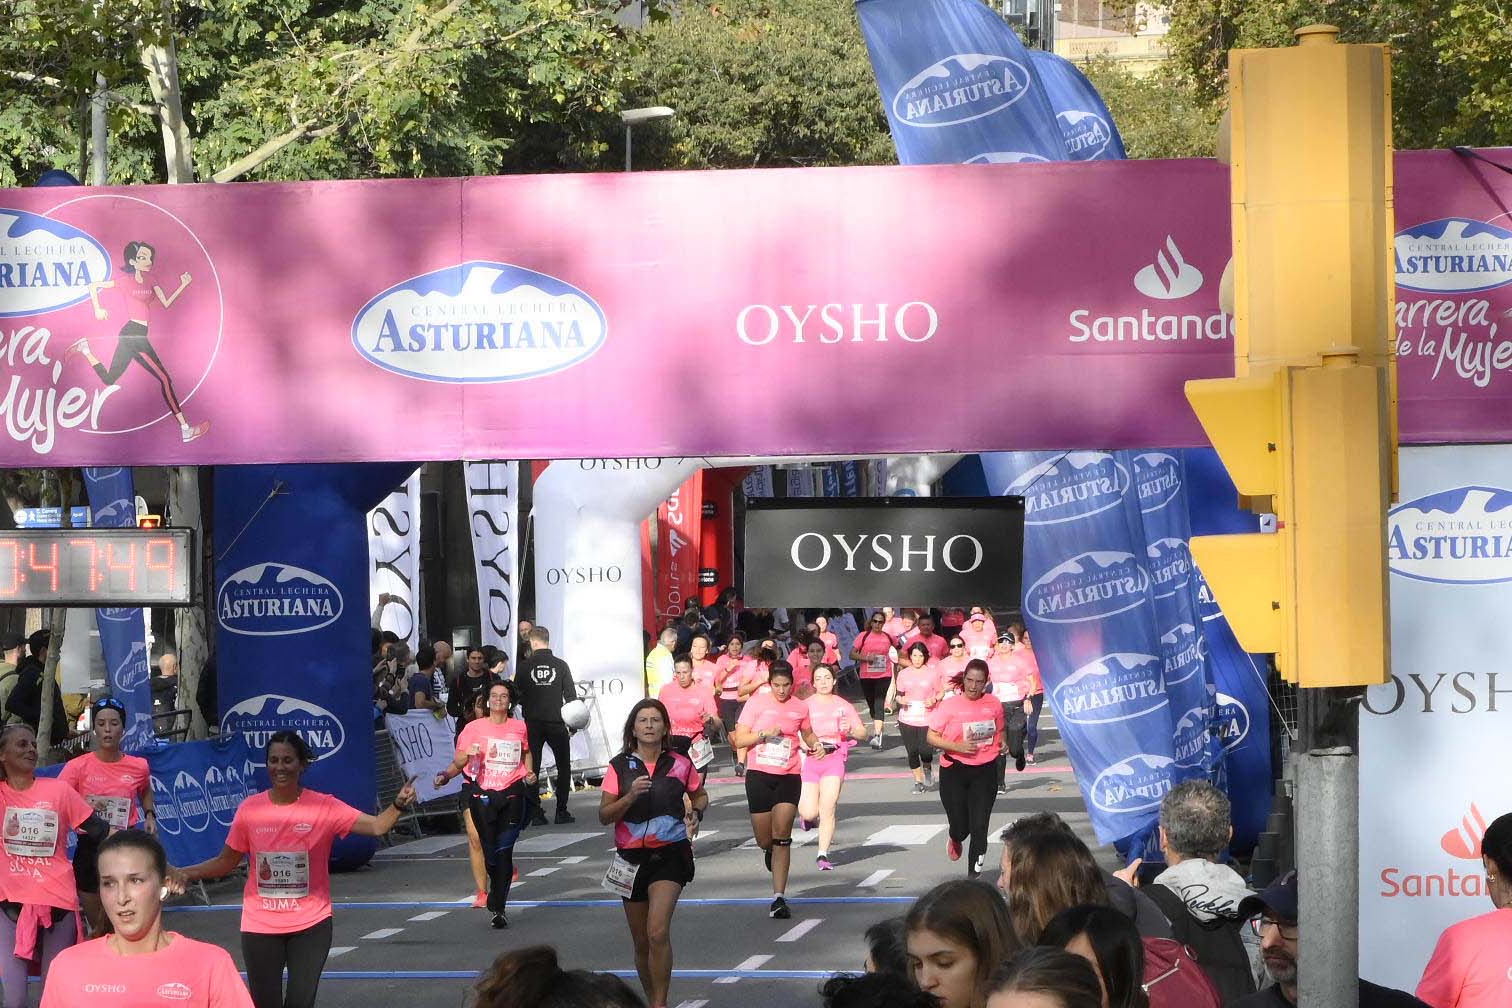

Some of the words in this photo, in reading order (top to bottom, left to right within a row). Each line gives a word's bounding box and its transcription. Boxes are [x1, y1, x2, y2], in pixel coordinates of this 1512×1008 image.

[14, 246, 87, 256] LECHERA
[1408, 241, 1463, 251] CENTRAL
[1466, 241, 1512, 251] LECHER
[410, 303, 493, 317] CENTRAL
[498, 302, 579, 315] LECHERA
[1395, 298, 1490, 328] arrera
[371, 308, 587, 355] ASTURIANA
[735, 301, 939, 346] OYSHO
[1069, 308, 1235, 341] Santand
[1418, 330, 1436, 356] la
[1432, 322, 1512, 387] Muje
[1416, 520, 1482, 531] CENTRAL
[791, 532, 984, 574] OYSHO
[546, 565, 622, 585] OYSHO
[281, 587, 329, 595] LECHERA
[221, 592, 334, 620] ASTURIANA
[537, 670, 550, 678] BP
[578, 678, 624, 696] SHO
[1360, 671, 1512, 716] OYSH
[236, 719, 277, 727] CENTRAL
[281, 719, 330, 727] LECHERA
[21, 826, 39, 835] 016
[1380, 867, 1492, 898] Santa
[263, 898, 299, 910] SUMA
[84, 984, 126, 993] OYSHO
